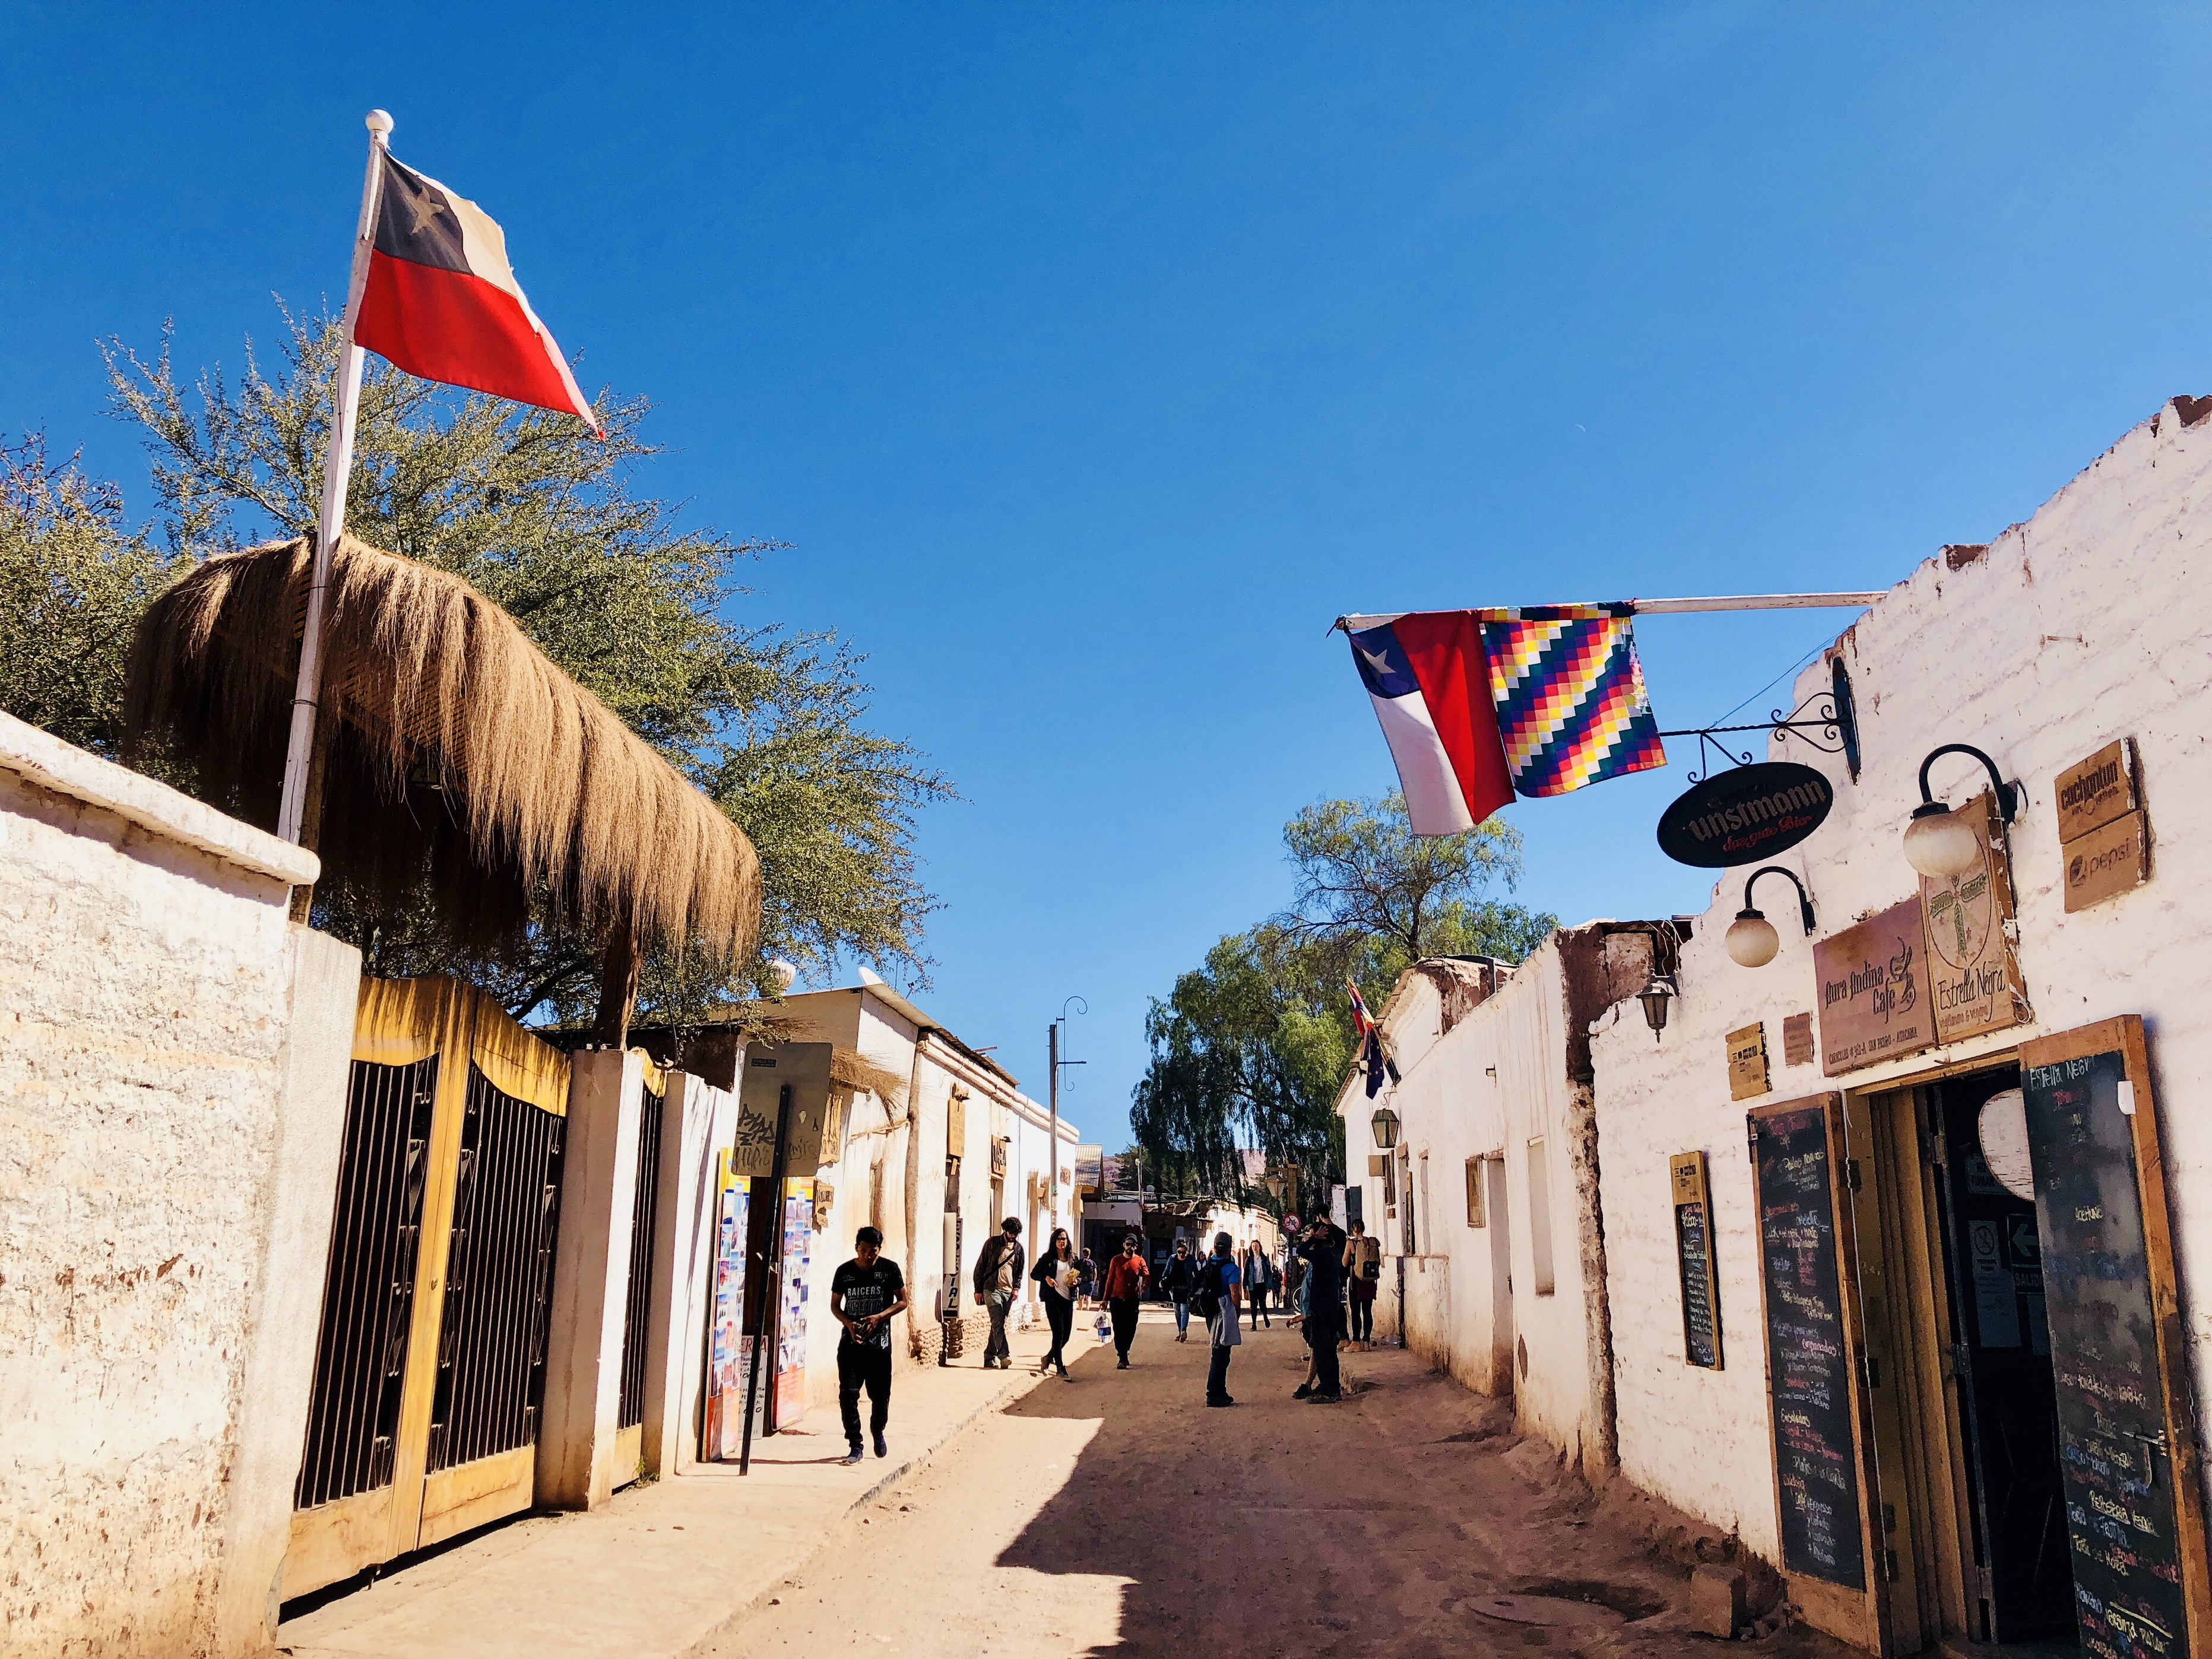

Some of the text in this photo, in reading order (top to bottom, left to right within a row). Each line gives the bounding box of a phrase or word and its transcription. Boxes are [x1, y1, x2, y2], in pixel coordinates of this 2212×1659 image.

[2089, 838, 2131, 876] pepsi
[1938, 961, 2006, 1022] Estrella Negra
